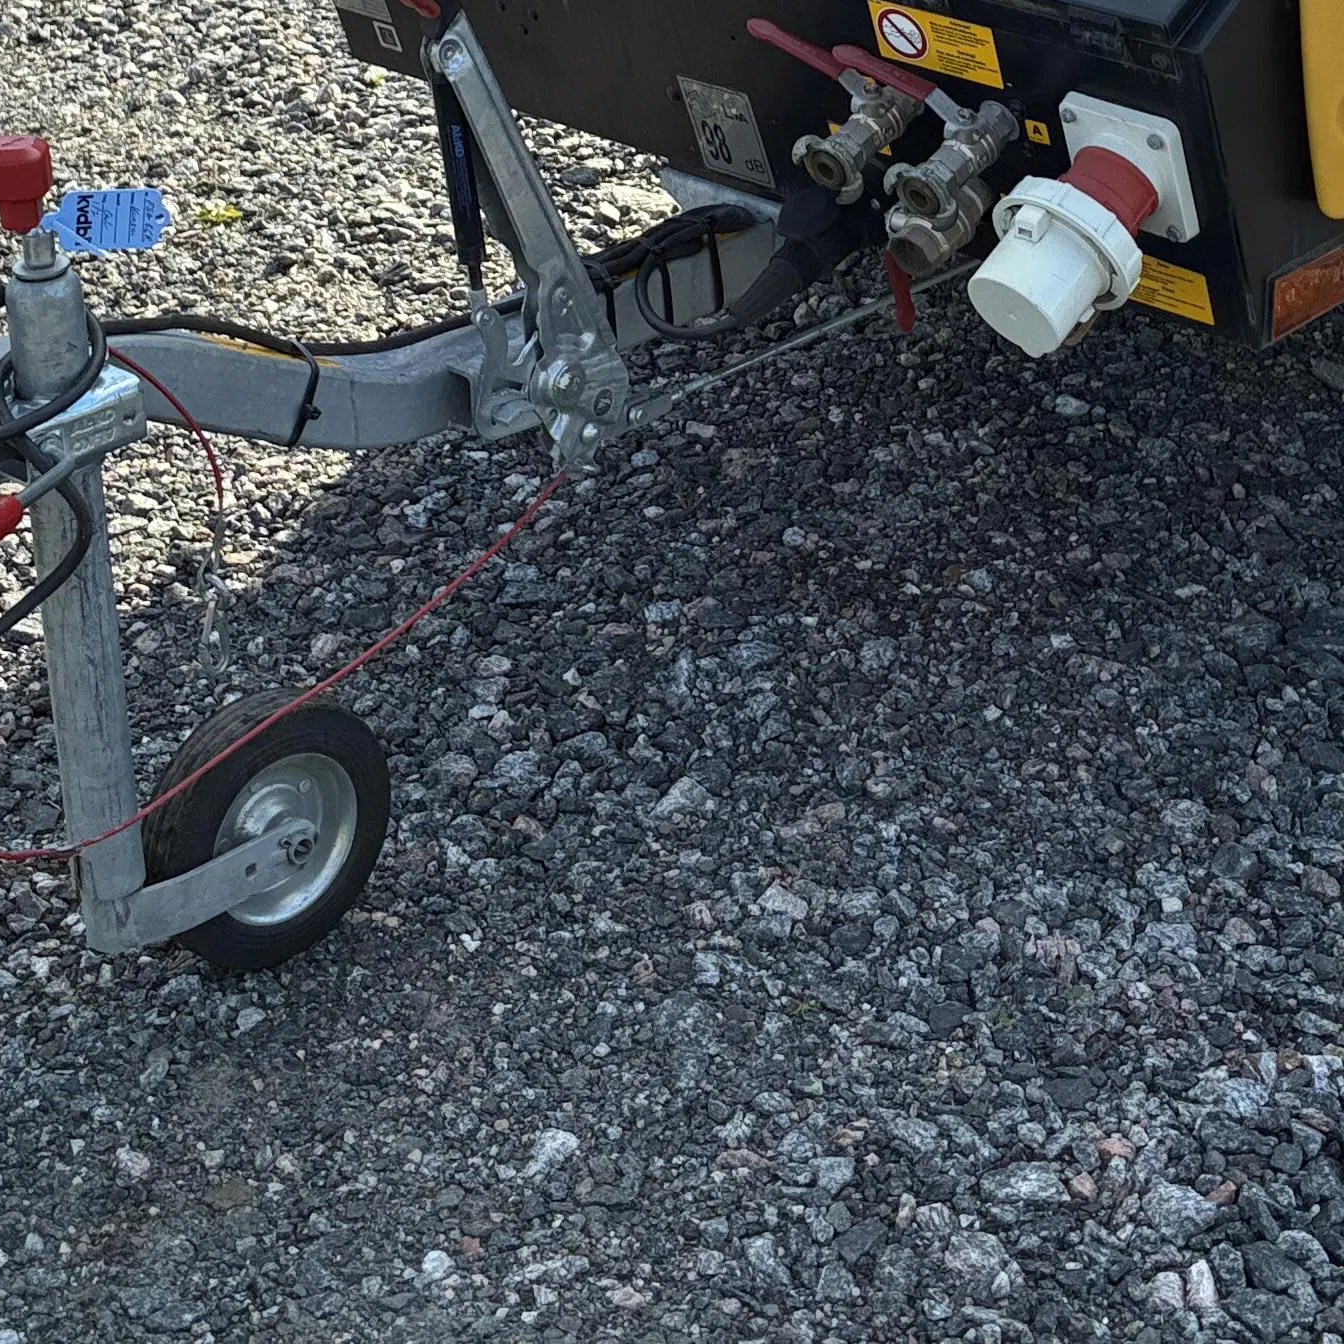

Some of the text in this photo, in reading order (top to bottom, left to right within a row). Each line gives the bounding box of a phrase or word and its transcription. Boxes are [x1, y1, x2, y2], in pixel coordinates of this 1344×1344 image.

[701, 120, 733, 165] 98
[1032, 124, 1044, 137] A
[744, 159, 766, 175] dB
[75, 194, 94, 246] kvdb
